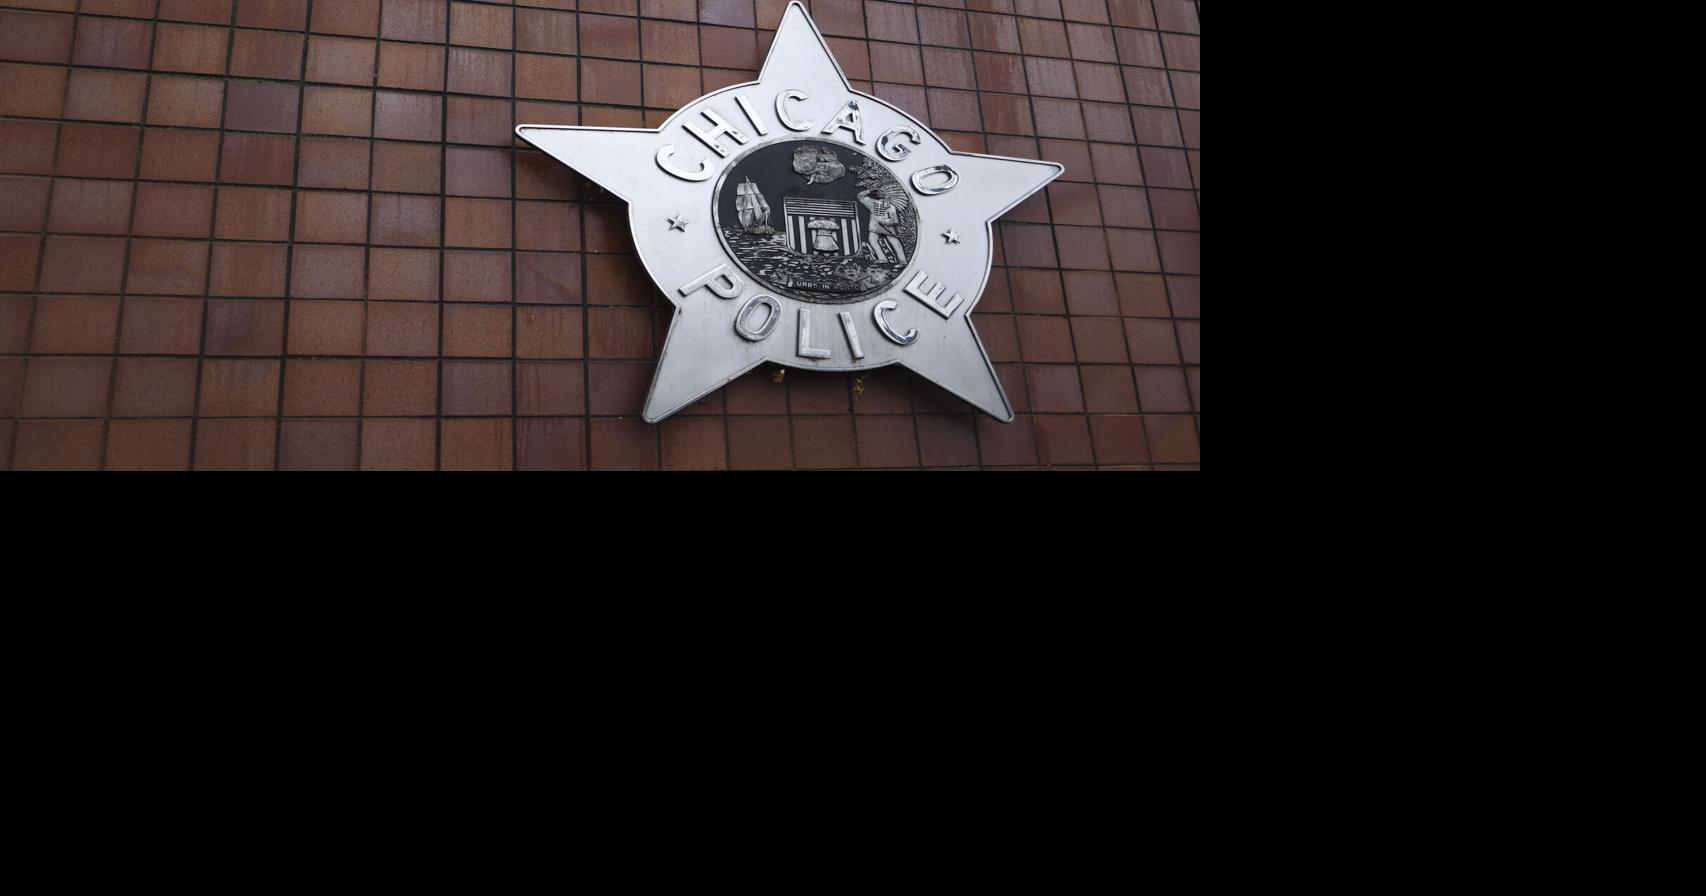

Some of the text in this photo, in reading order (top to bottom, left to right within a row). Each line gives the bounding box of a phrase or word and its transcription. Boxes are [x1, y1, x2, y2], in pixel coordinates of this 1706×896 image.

[656, 89, 960, 195] CHICAGO
[681, 263, 965, 359] POLICE
[796, 281, 818, 289] URBS
